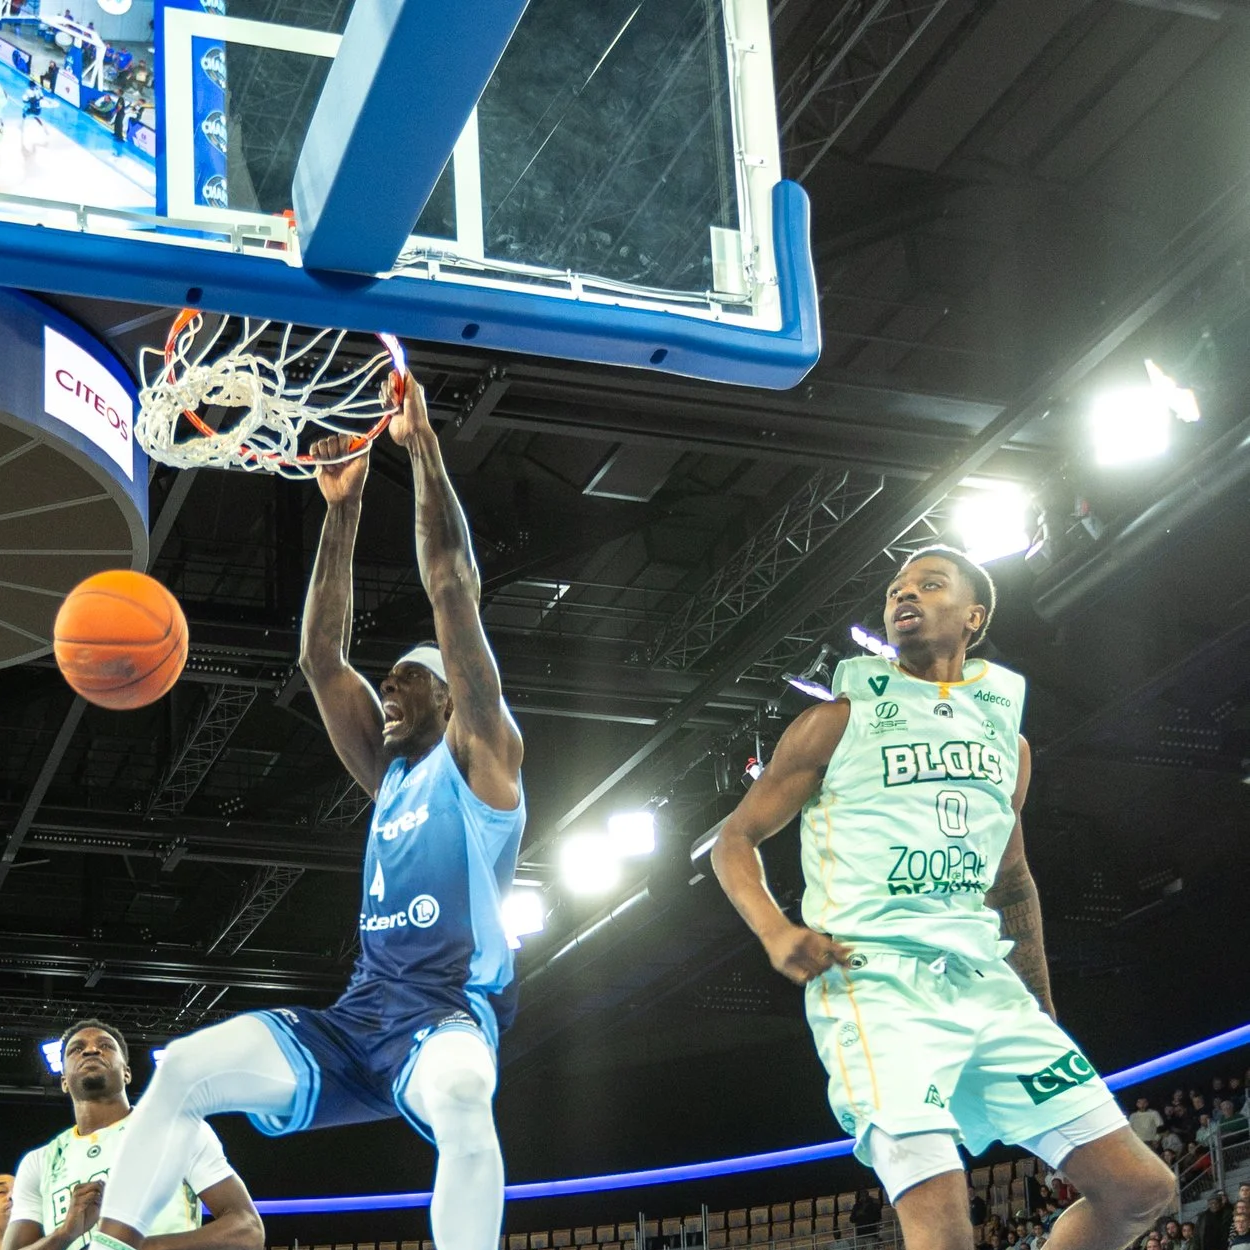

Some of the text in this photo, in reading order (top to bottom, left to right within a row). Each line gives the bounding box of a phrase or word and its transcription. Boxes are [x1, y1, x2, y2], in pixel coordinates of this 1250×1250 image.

[55, 369, 128, 441] CITEOS
[974, 690, 1011, 708] Adecco
[882, 740, 1003, 788] BLOIS
[936, 790, 970, 838] 0
[1031, 1053, 1091, 1096] CIC
